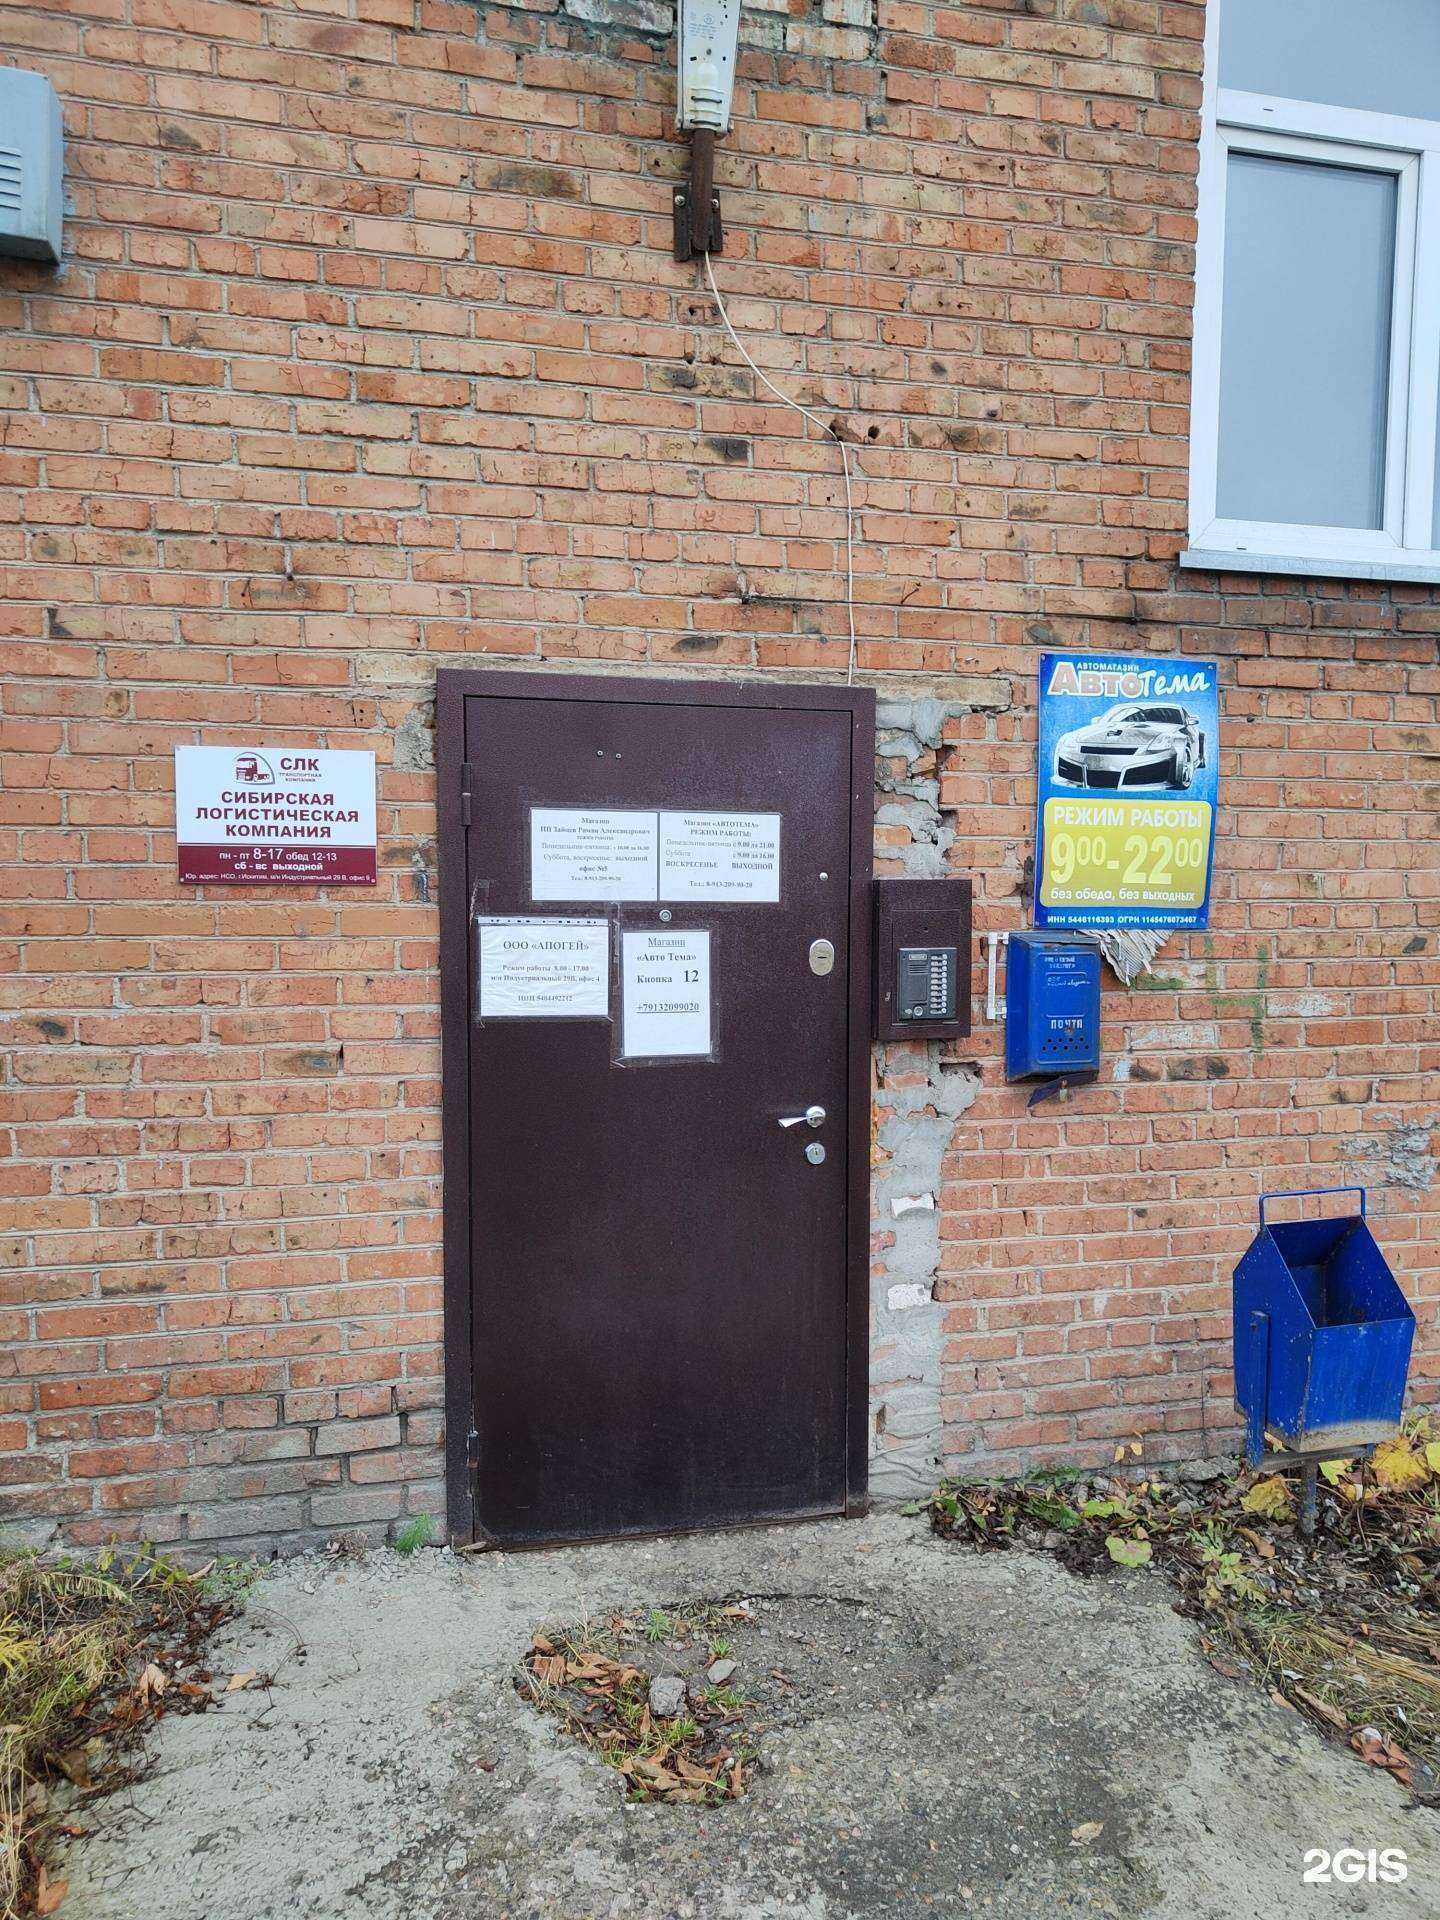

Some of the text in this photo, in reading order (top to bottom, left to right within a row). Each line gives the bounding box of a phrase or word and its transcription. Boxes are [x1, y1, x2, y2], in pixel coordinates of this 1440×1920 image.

[1077, 662, 1139, 672] АВТОМАГАЗИН
[280, 757, 319, 771] СЛК
[221, 791, 334, 805] СИБИРСКАЯ
[196, 807, 359, 822] ЛОГИСТИЧЕСКАЯ
[1053, 806, 1202, 828] РЕЖИМ РАБОТЫ
[225, 824, 331, 838] КОМПАНИЯ
[600, 827, 650, 835] Александрович
[219, 852, 231, 860] пн
[239, 852, 250, 860] пт
[253, 847, 283, 860] 8-17
[285, 851, 309, 861] обед
[312, 852, 337, 861] 12-13
[234, 862, 247, 870] сб
[272, 862, 323, 871] выходной
[732, 862, 773, 870] ВЫХОДНОЙ
[1051, 887, 1072, 900] без
[1119, 888, 1139, 900] без
[1142, 890, 1196, 902] выходных
[1047, 915, 1066, 923] ИНН
[503, 938, 589, 950] ООО «АПОГЕЙ»
[648, 937, 686, 946] Магазин
[636, 952, 697, 961] «Авто Тема»
[637, 969, 699, 983] Кнопка 12
[1050, 1019, 1083, 1029] ПОЧТА
